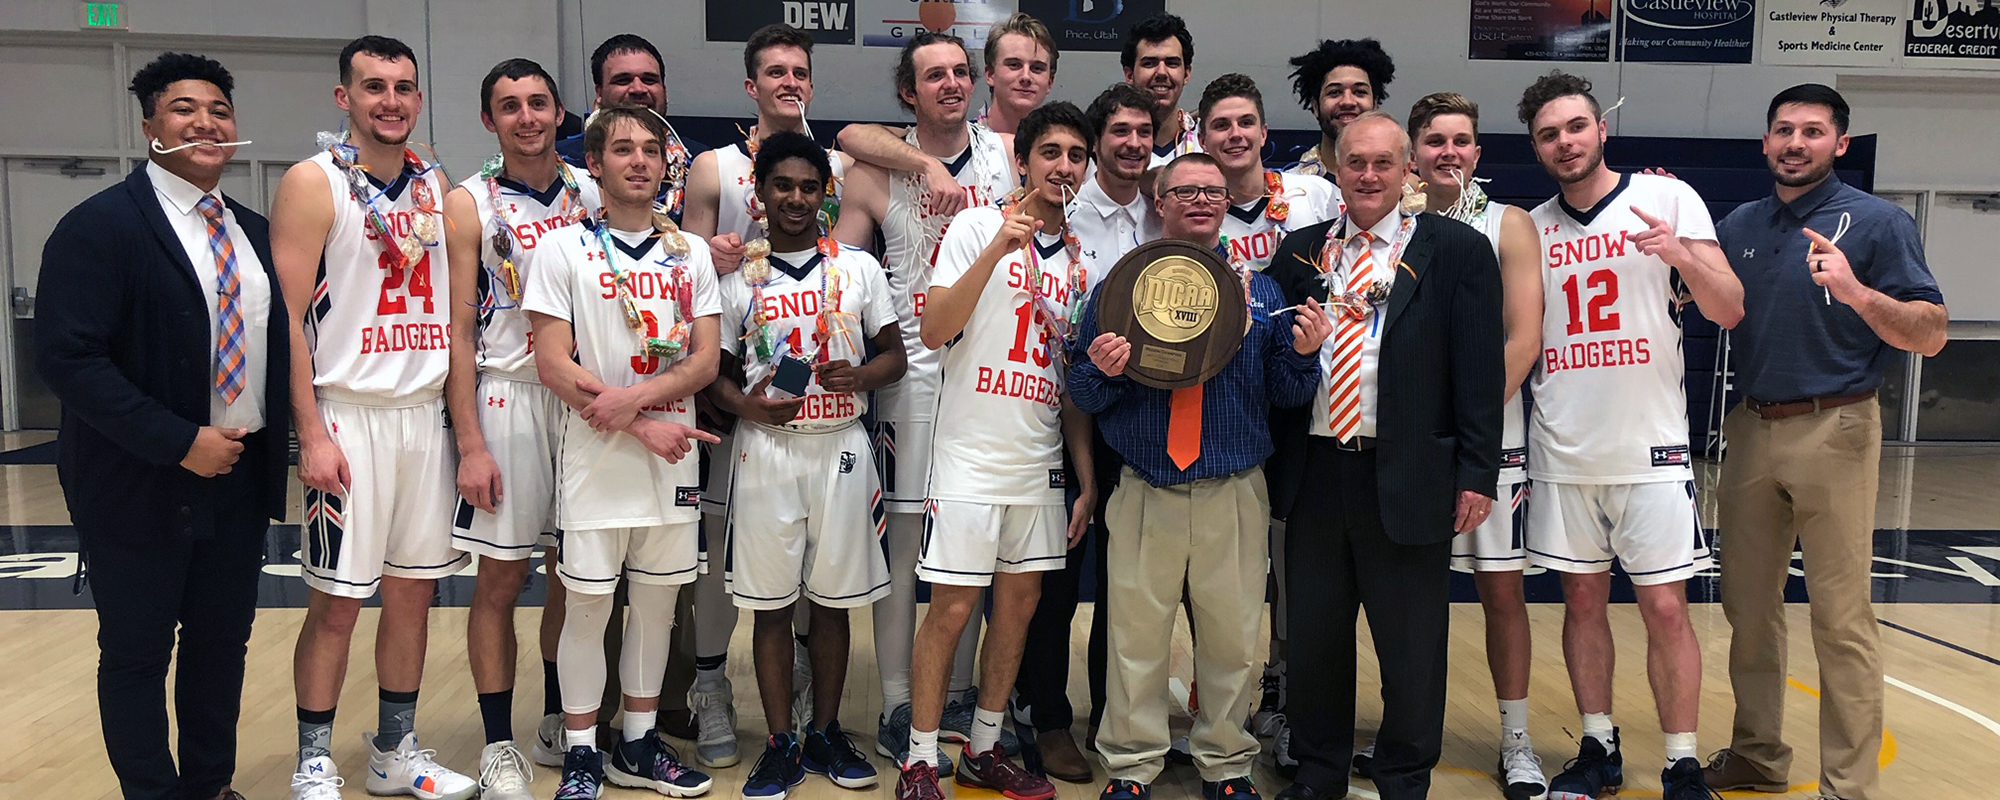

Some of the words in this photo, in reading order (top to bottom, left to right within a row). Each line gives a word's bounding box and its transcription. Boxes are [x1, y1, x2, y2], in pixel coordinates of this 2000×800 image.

[87, 4, 119, 26] EXIT
[783, 2, 848, 30] DEW
[1693, 11, 1737, 20] HOSPITAL
[1769, 11, 1818, 22] Castleview
[1821, 12, 1857, 24] Physical
[1860, 13, 1897, 25] Therapy
[1912, 0, 2000, 38] Desertv
[1065, 29, 1092, 40] Price,
[1094, 28, 1118, 39] Utah
[1651, 39, 1665, 47] our
[1666, 38, 1712, 49] Community
[1713, 39, 1750, 48] Healthier
[1828, 26, 1836, 35] &
[1778, 40, 1808, 52] Sports
[1811, 41, 1851, 51] Medicine
[1853, 41, 1883, 51] Center
[1907, 43, 1955, 54] FEDERAL
[1958, 44, 1998, 55] CREDIT
[516, 215, 567, 250] SNO
[1229, 232, 1275, 261] NO
[1549, 230, 1628, 268] SNOW
[377, 250, 435, 316] 24
[1141, 276, 1214, 313] NJCAA
[1174, 310, 1198, 322] XVIII
[1562, 269, 1621, 336] 12
[1008, 301, 1053, 369] 13
[1544, 338, 1651, 374] BADGERS
[975, 366, 1061, 407] BADGERS
[793, 393, 855, 420] DGERS
